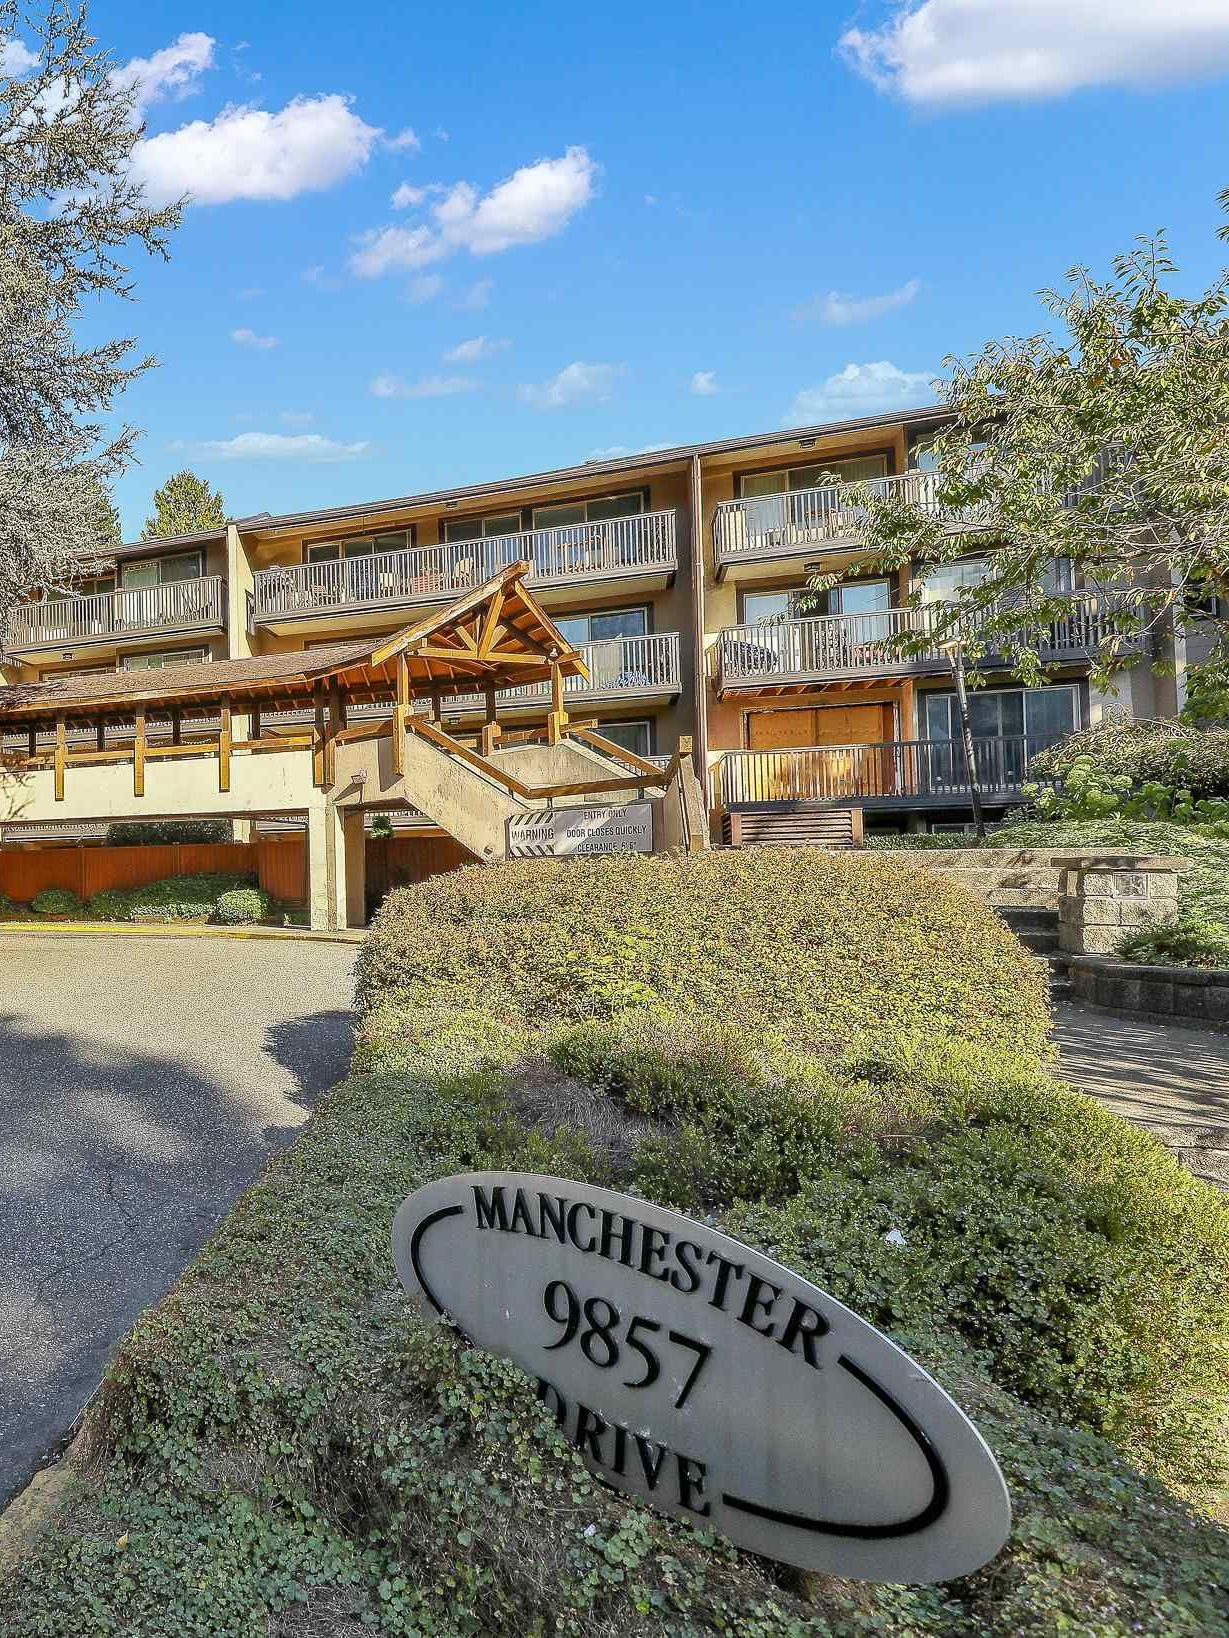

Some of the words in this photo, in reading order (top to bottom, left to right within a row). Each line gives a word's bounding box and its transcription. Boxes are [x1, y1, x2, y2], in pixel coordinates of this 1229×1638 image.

[584, 811, 606, 820] ENTRY
[608, 809, 627, 818] ONLY
[511, 828, 554, 841] WARNING
[566, 828, 586, 838] DOOR
[587, 827, 614, 837] CLOSES
[615, 825, 647, 836] QUICKLY
[471, 1185, 830, 1369] MANCHESTER
[543, 1280, 712, 1409] 9857
